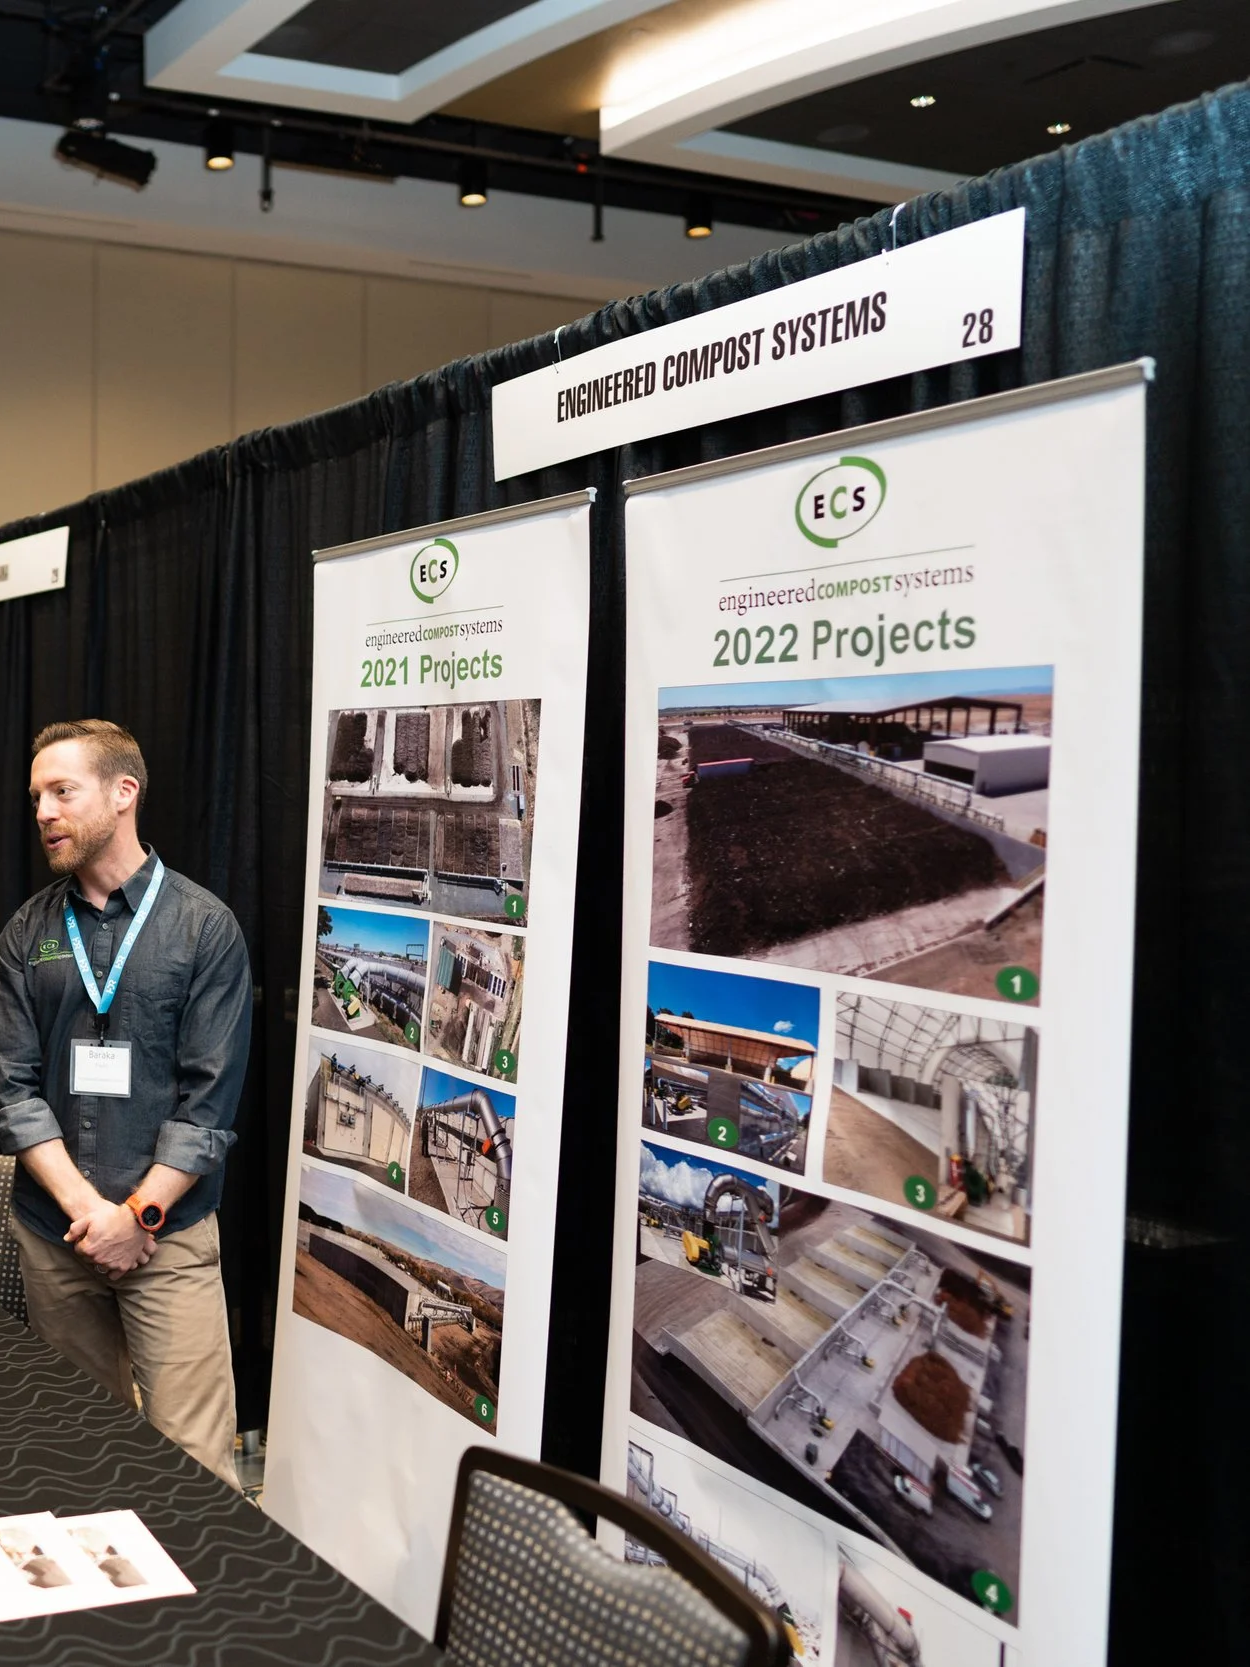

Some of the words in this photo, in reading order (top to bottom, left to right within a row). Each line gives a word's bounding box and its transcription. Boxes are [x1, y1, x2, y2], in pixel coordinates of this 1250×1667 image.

[557, 361, 656, 423] ENGINEERED
[663, 327, 765, 391] COMPOST
[771, 291, 887, 361] SYSTEMS
[962, 308, 994, 348] 28
[813, 485, 866, 521] ECS
[419, 559, 448, 584] ECS
[713, 622, 798, 667] 2022
[812, 608, 976, 667] Projects
[360, 655, 408, 688] 2021
[419, 649, 503, 690] Projects
[511, 900, 517, 913] 1
[1010, 974, 1022, 995] 1
[410, 1026, 415, 1039] 2
[502, 1056, 508, 1069] 3
[717, 1126, 727, 1142] 2
[391, 1168, 397, 1180] 4
[915, 1183, 926, 1203] 3
[492, 1212, 499, 1225] 5
[481, 1403, 488, 1416] 6
[985, 1584, 999, 1603] 4
